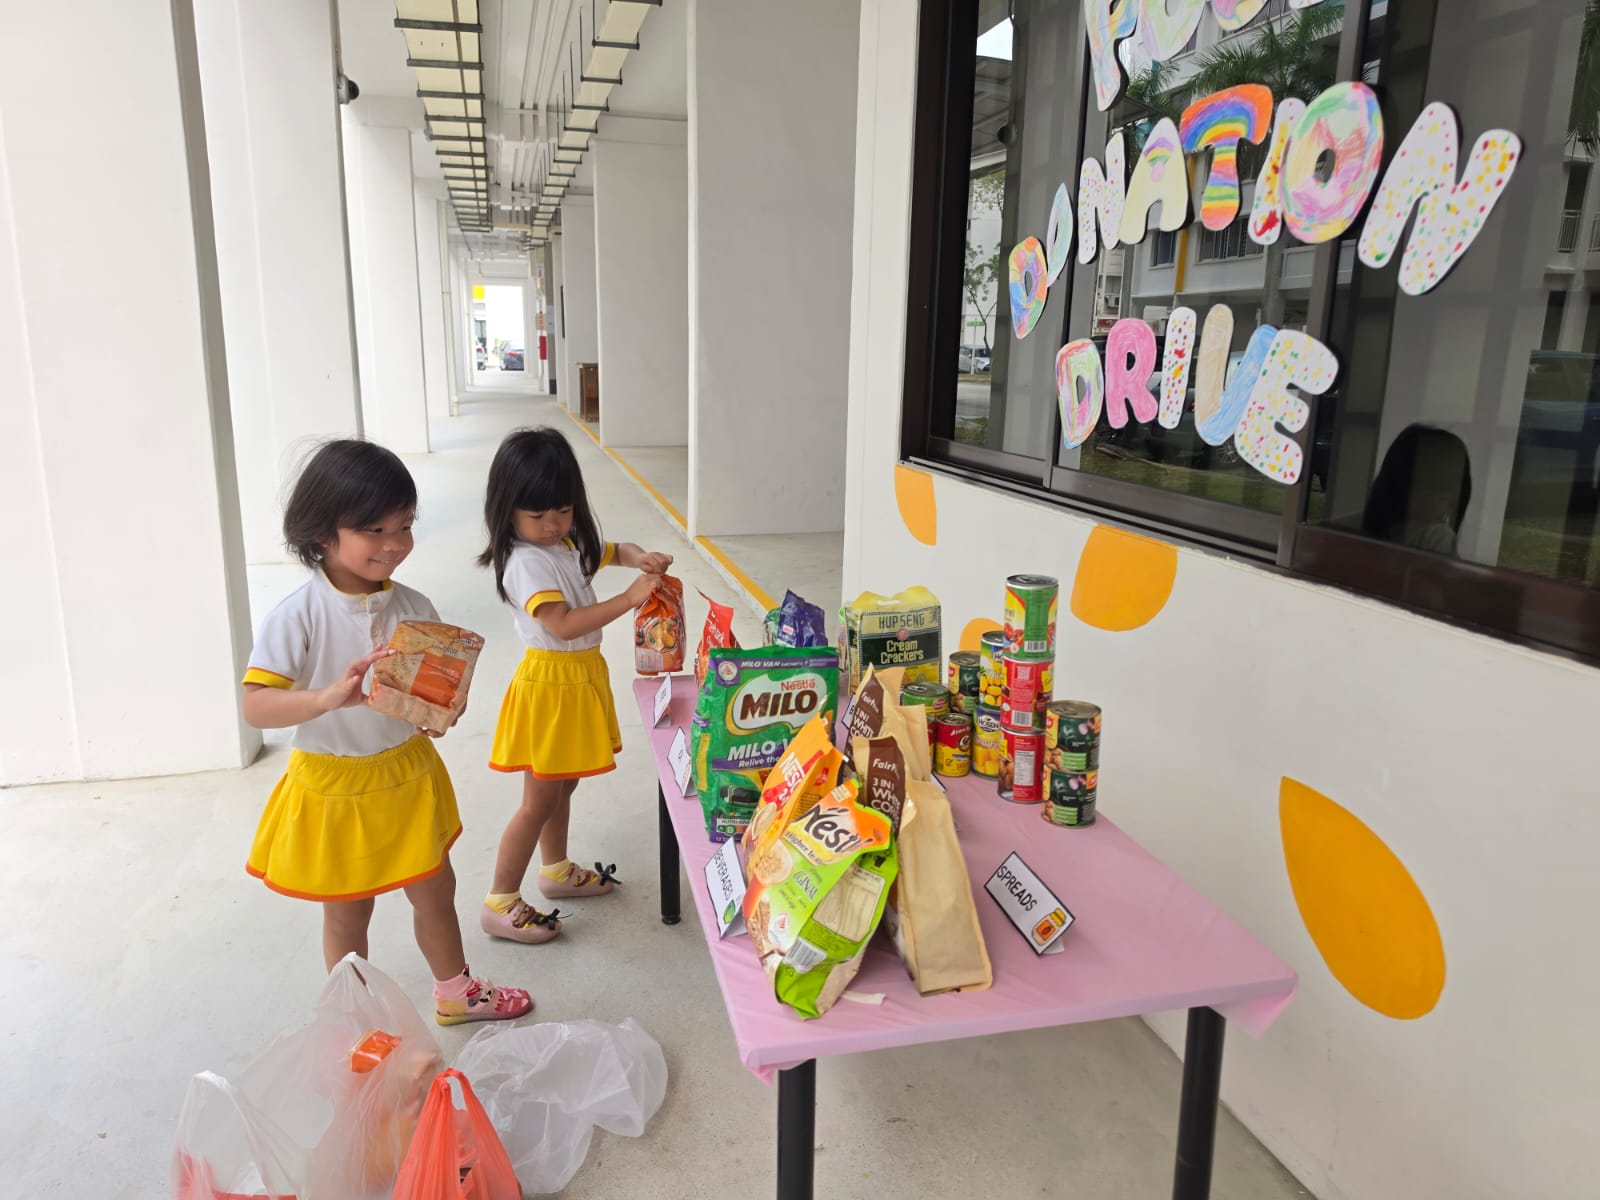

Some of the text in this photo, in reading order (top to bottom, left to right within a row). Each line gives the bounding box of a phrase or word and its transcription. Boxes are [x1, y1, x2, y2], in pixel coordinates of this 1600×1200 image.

[1008, 81, 1522, 340] DONATION
[1056, 304, 1339, 485] DRIVE
[878, 614, 899, 630] HUP
[880, 649, 924, 665] Crackers
[886, 639, 918, 653] Cream
[739, 689, 819, 721] MILO
[727, 740, 777, 762] MILO
[996, 865, 1038, 912] SPREADS
